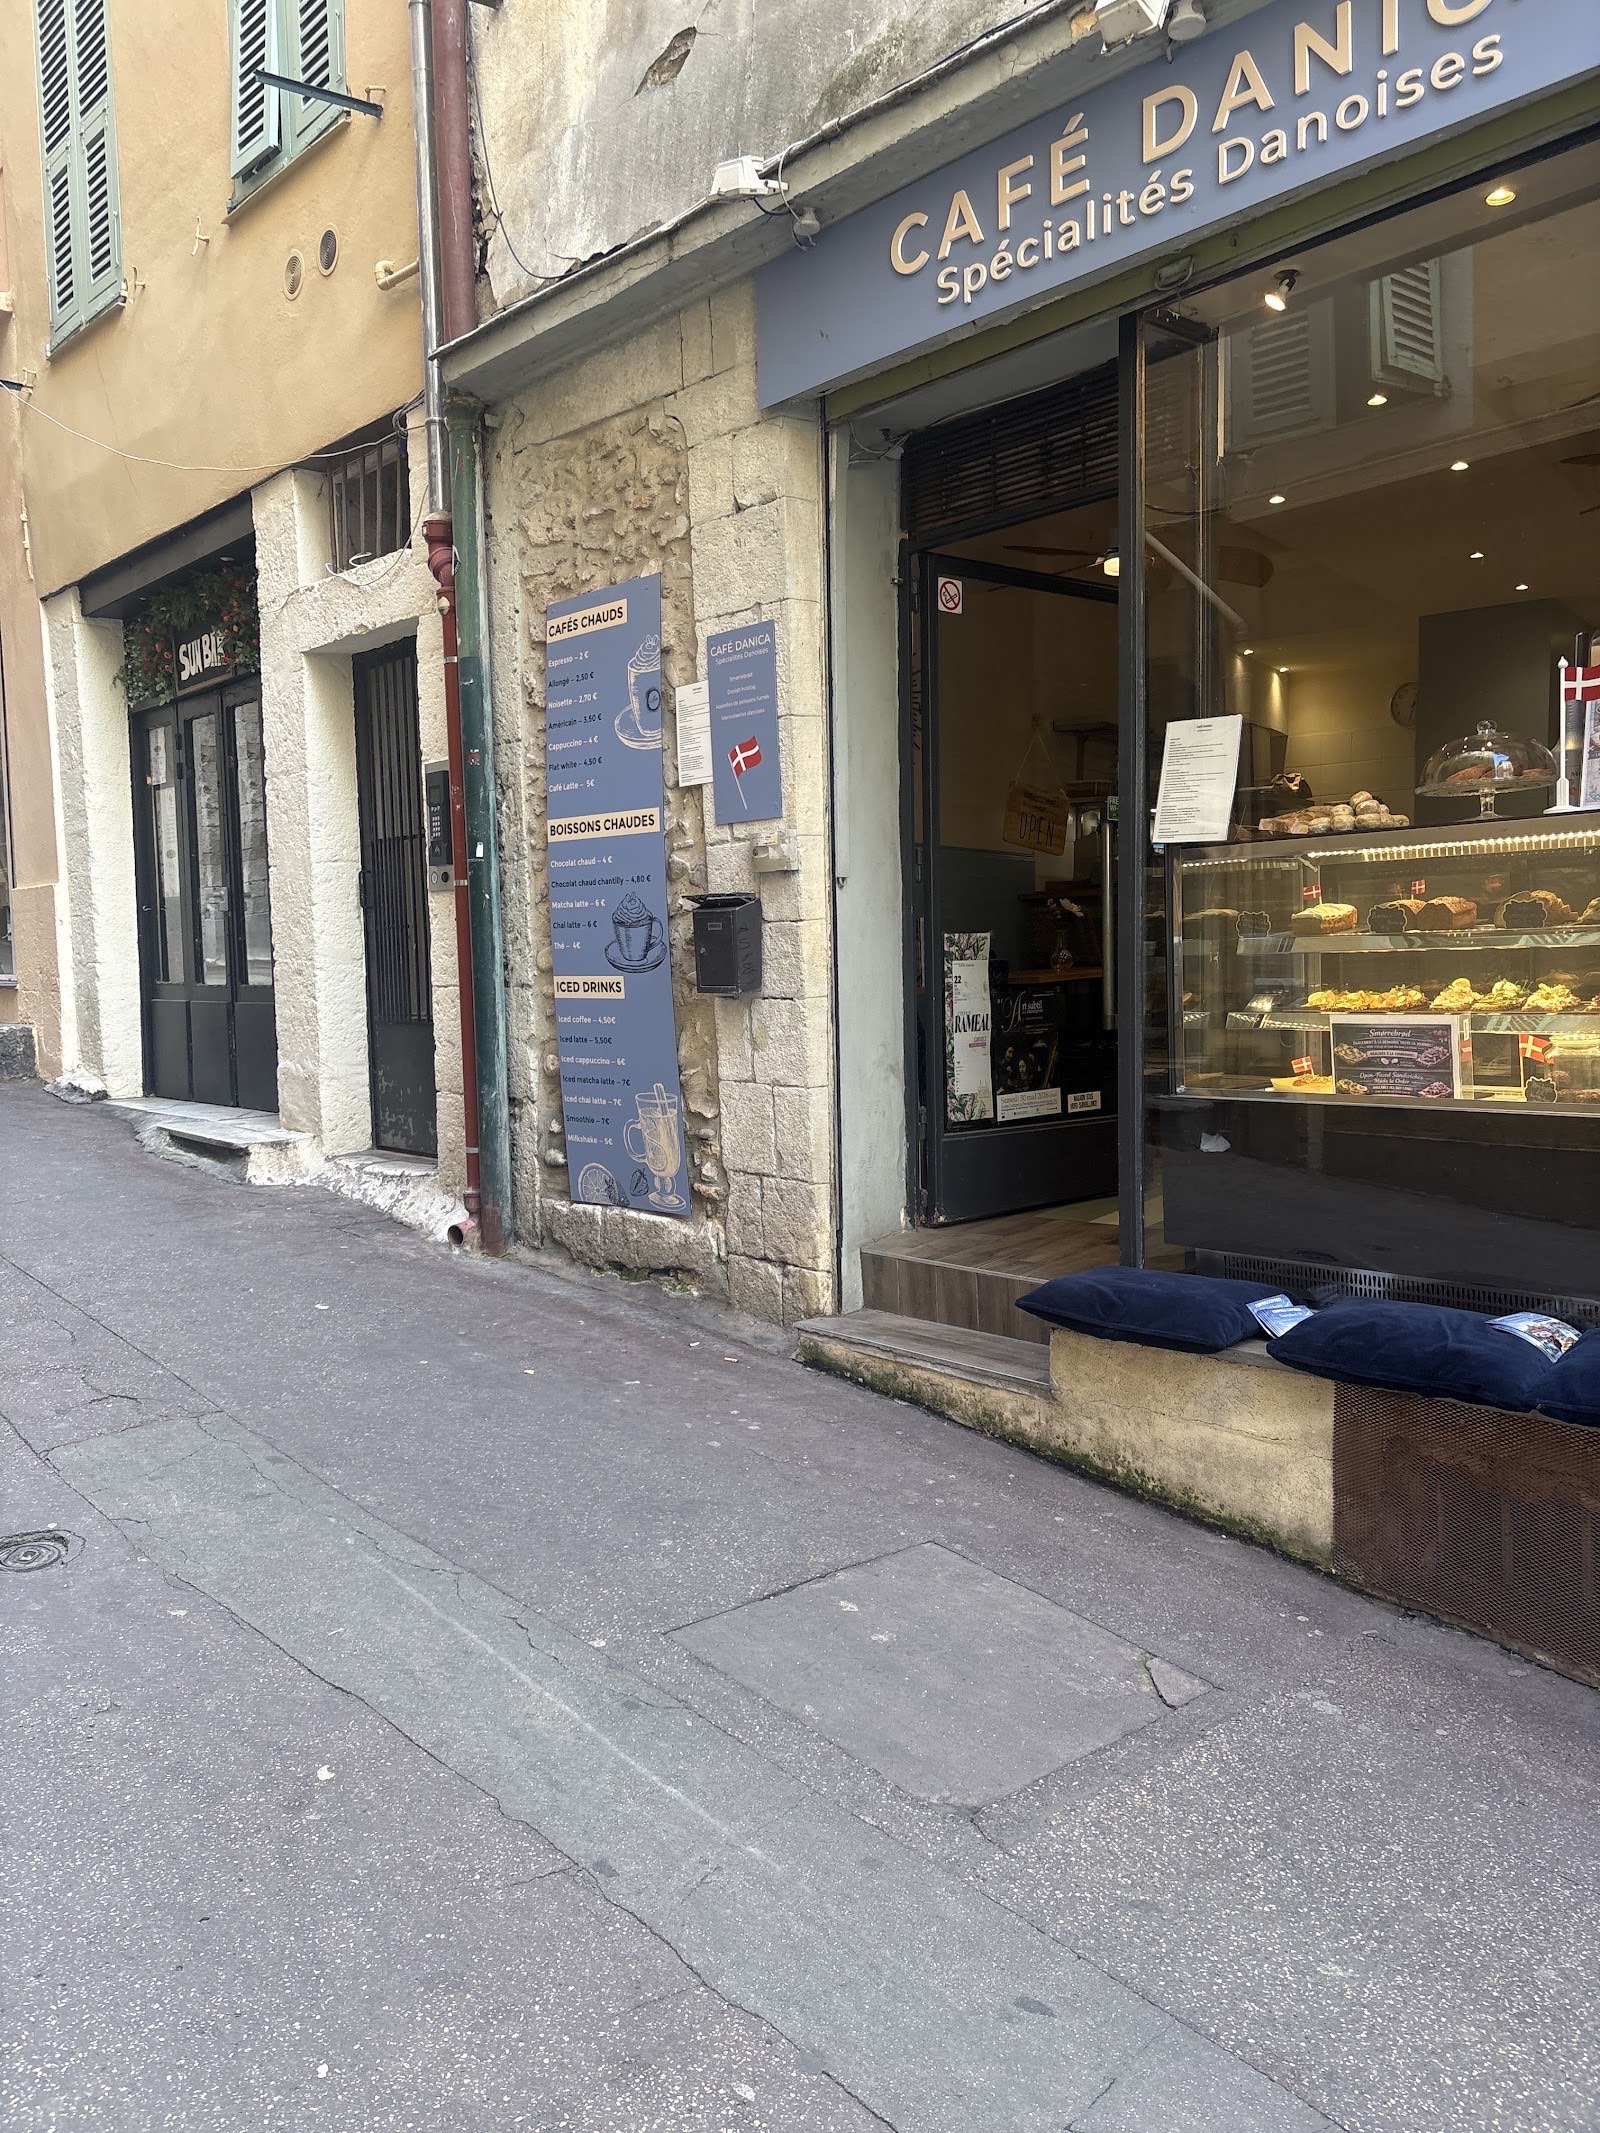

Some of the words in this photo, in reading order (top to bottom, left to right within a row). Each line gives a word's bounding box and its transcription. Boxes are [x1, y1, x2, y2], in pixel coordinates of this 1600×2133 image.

[937, 168, 1194, 304] Spécialités
[1218, 34, 1503, 185] Danoises
[890, 112, 1090, 275] CAFÉ
[548, 617, 578, 637] CAFÉS
[581, 606, 623, 628] CHAUDS
[710, 641, 733, 657] CAFÉ
[735, 633, 771, 651] DANICA
[179, 638, 203, 680] SUN
[548, 656, 573, 667] Espresso
[579, 652, 583, 660] 2
[584, 650, 589, 659] €
[548, 677, 569, 688] Allongé
[576, 672, 588, 682] 2,50
[589, 671, 594, 679] €
[548, 698, 572, 709] Noisette
[578, 694, 591, 703] 2,70
[592, 692, 597, 700] €
[548, 718, 577, 730] Américain
[583, 714, 596, 723] 3,50
[548, 739, 582, 751] Cappuccino
[593, 735, 598, 743] €
[560, 761, 577, 770] white
[583, 757, 596, 766] 4,50
[598, 756, 602, 764] €
[548, 783, 562, 792] Café
[563, 782, 578, 790] Latte
[550, 820, 601, 836] BOISSONS
[603, 814, 655, 831] CHAUDES
[1020, 811, 1055, 847] OPEN
[550, 859, 576, 868] Chocolat
[577, 857, 595, 866] chaud
[578, 879, 596, 887] chaud
[598, 877, 624, 886] chantilly
[631, 875, 645, 884] 4,80
[646, 874, 651, 882] €
[552, 901, 573, 909] Matcha
[574, 900, 589, 908] latte
[556, 981, 580, 993] ICED
[582, 981, 622, 993] DRINKS
[572, 1015, 591, 1023] coffee
[598, 1016, 616, 1024] 4,50€
[1369, 1028, 1411, 1038] Smørrebrød
[560, 1055, 574, 1063] Iced
[575, 1056, 610, 1065] cappuccino
[616, 1057, 625, 1065] 6€
[577, 1076, 599, 1084] matcha
[566, 1115, 594, 1123] Smoothie
[568, 1134, 597, 1143] Milkshake
